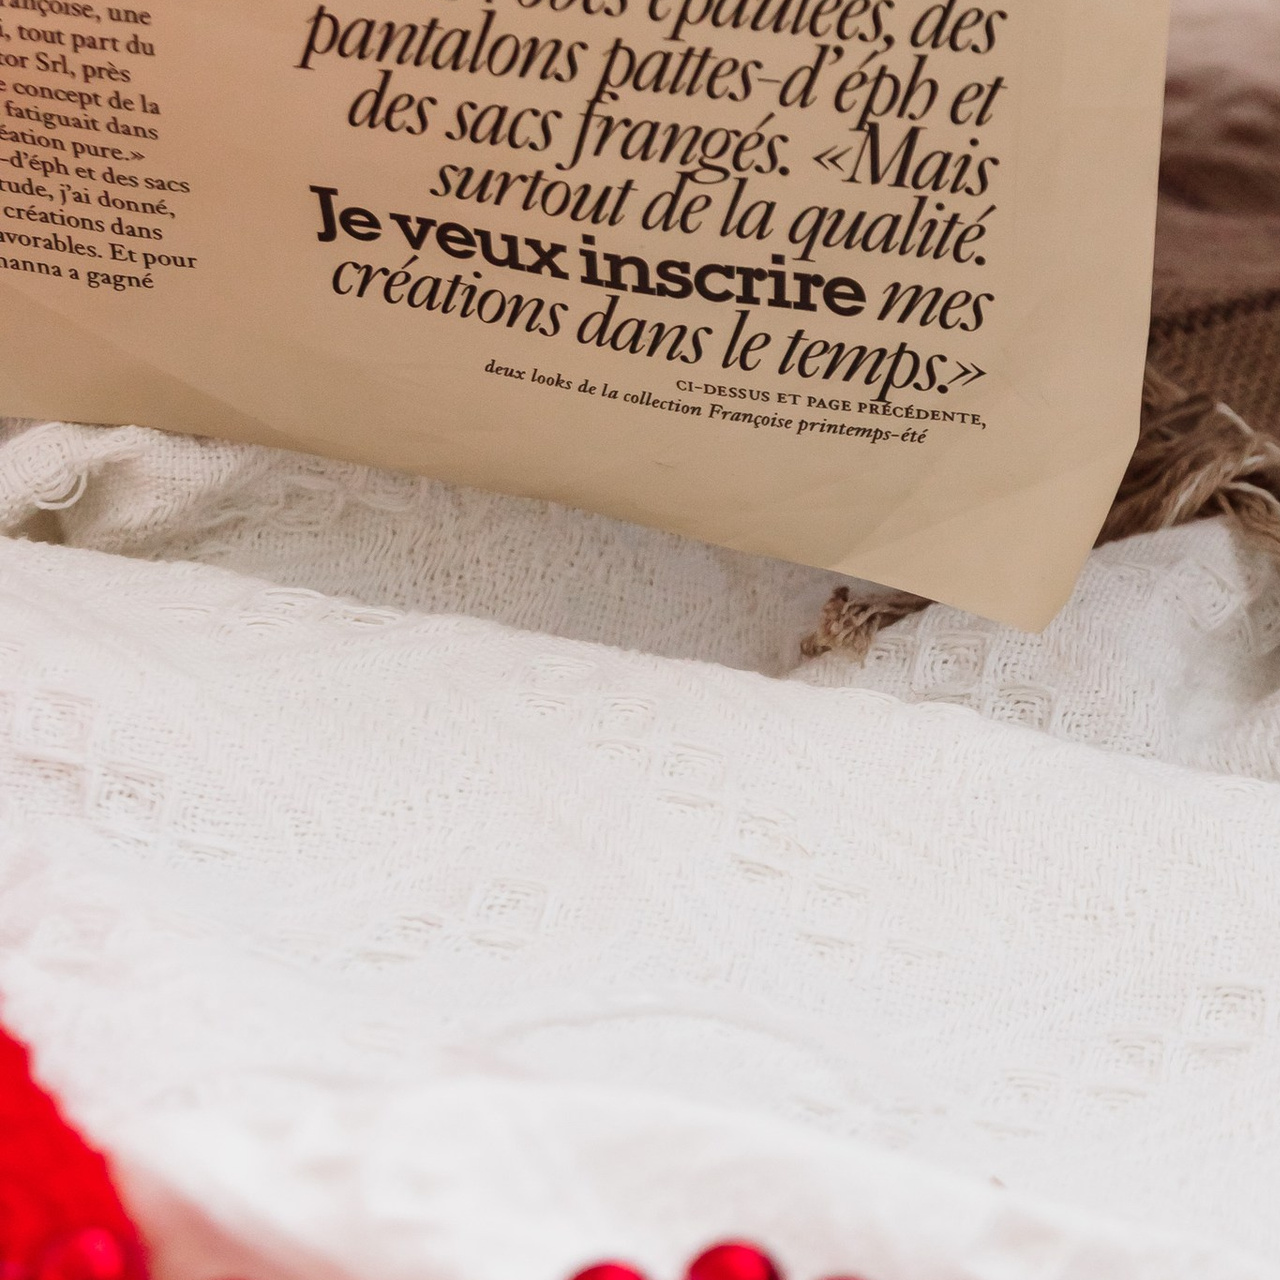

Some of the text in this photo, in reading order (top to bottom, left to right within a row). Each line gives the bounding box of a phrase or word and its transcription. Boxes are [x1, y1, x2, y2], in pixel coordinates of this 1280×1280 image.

[107, 7, 151, 25] une
[17, 24, 65, 45] tout
[71, 32, 119, 53] part
[126, 33, 155, 56] du
[35, 51, 75, 79] Srl,
[81, 61, 131, 83] près
[293, 4, 589, 82] pantalons
[950, 76, 1008, 126] et
[13, 81, 102, 110] concept
[108, 91, 135, 111] de
[141, 94, 160, 115] la
[5, 100, 159, 140] fatiguait dans
[348, 70, 1000, 196] des sacs frangés. «Mais
[71, 140, 145, 161] pure.»
[75, 167, 97, 181] et
[102, 166, 139, 188] des
[144, 176, 190, 193] sacs
[59, 183, 92, 206] j'ai
[98, 190, 176, 219] donné,
[429, 164, 996, 265] surtout de la qualité.
[3, 205, 163, 241] créations dans
[108, 242, 137, 263] Et
[142, 252, 198, 269] pour
[309, 185, 995, 332] Je veux inscrire mes
[69, 268, 80, 280] a
[87, 272, 154, 291] gagné
[332, 255, 987, 403] créations dans le temps.»
[485, 359, 927, 444] deux looks de la collection Françoise printemps-été
[676, 380, 987, 429] CI-DESSUS ET PAGE PRÉCÉDENTE,
